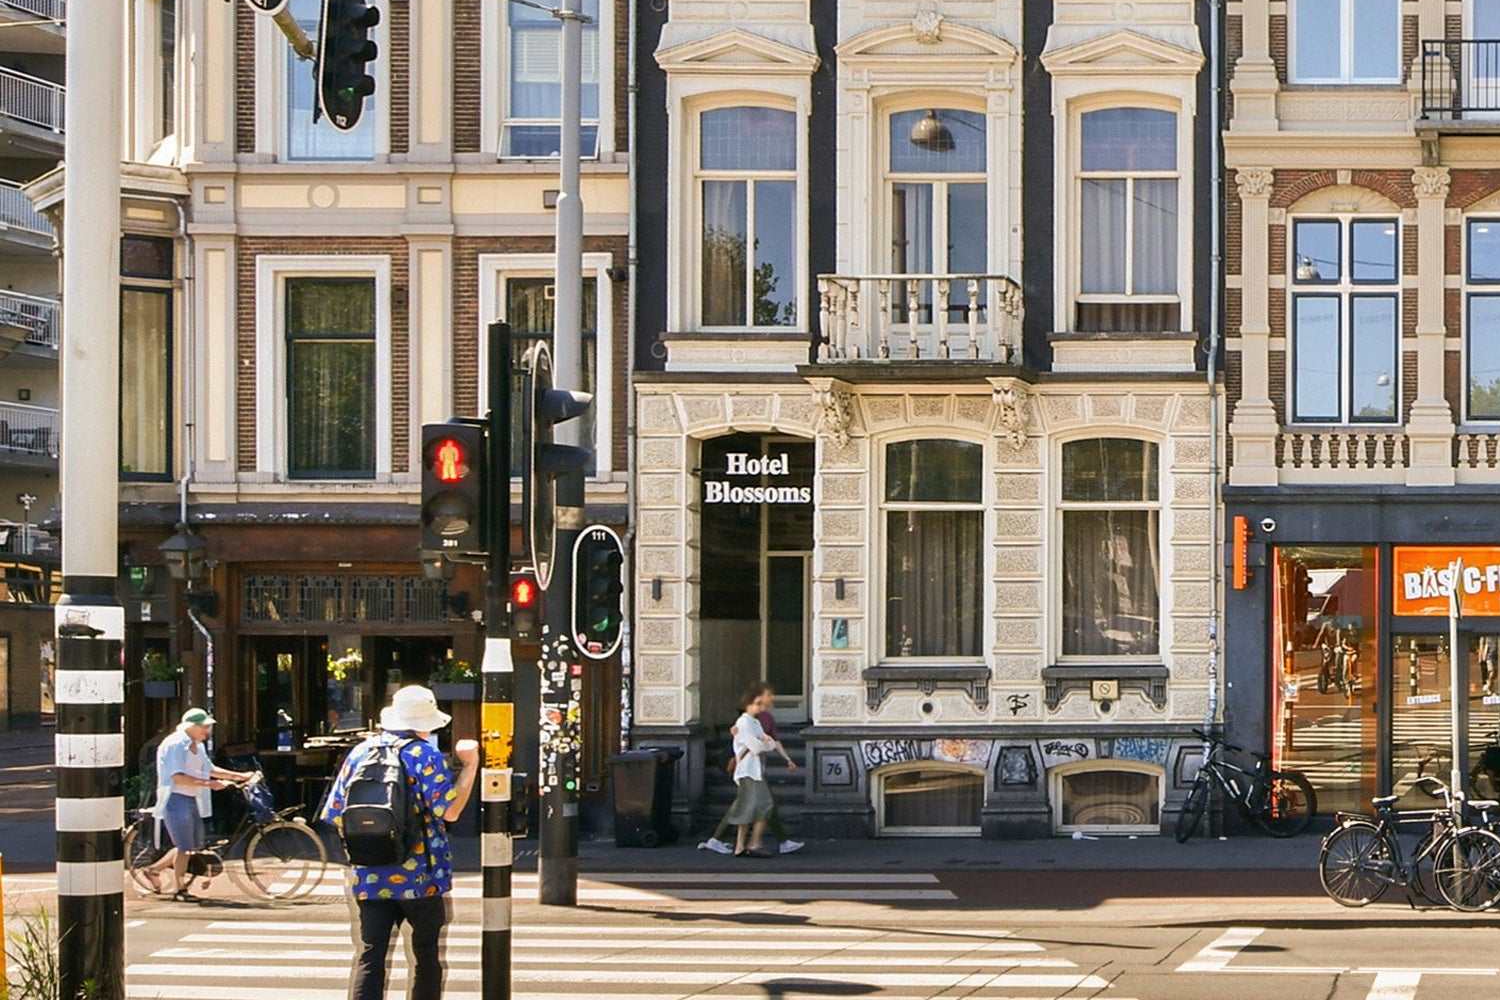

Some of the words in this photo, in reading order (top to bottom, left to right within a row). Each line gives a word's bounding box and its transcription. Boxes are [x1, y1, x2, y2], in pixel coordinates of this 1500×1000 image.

[725, 452, 789, 475] Hotel
[704, 481, 811, 503] Blossoms
[591, 531, 606, 541] 111
[827, 763, 842, 775] 76
